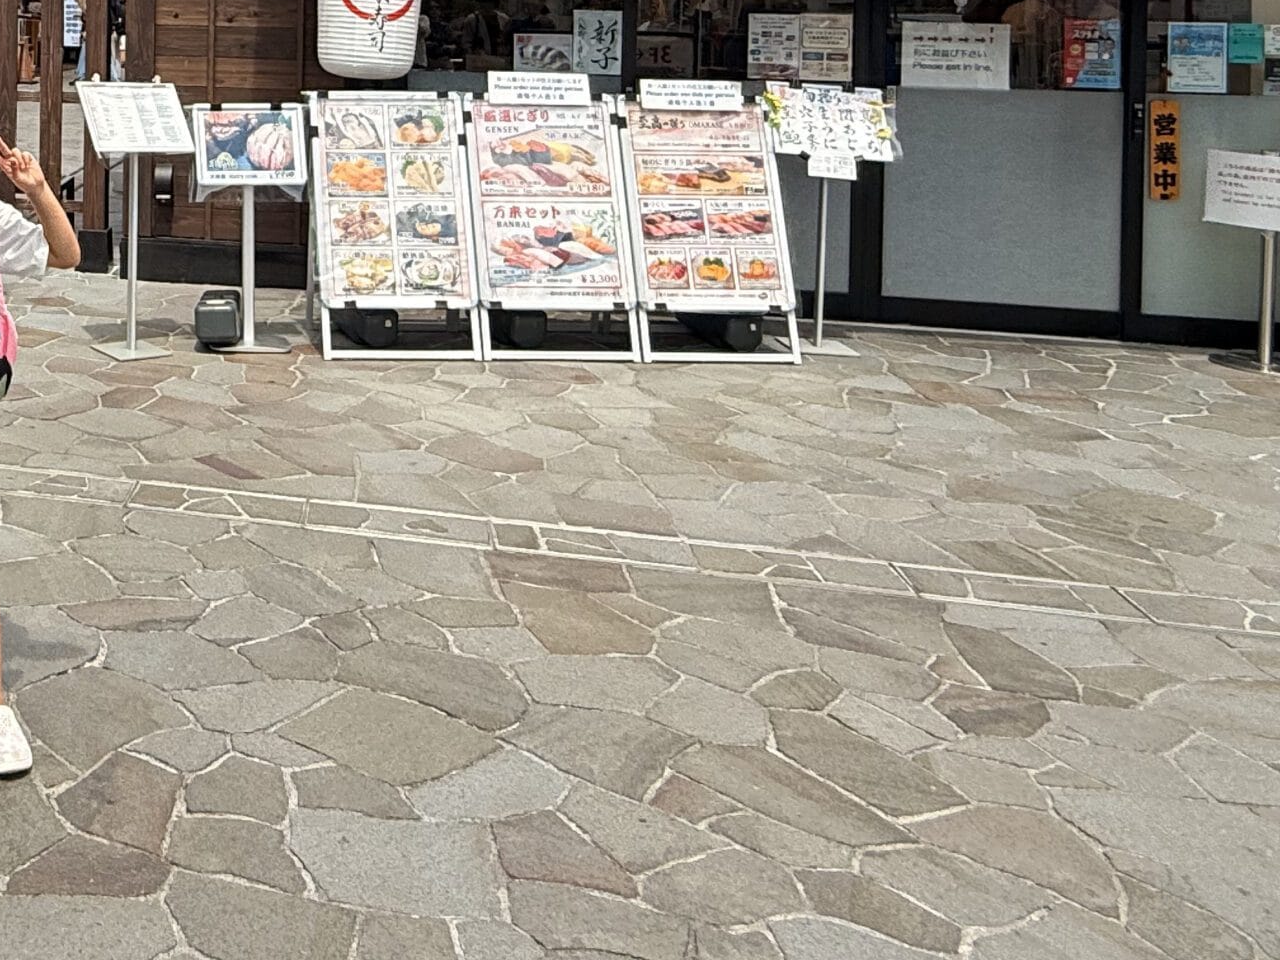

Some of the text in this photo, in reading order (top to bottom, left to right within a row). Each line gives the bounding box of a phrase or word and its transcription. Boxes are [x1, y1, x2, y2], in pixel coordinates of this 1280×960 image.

[590, 19, 619, 70] 新子
[912, 62, 943, 70] Please
[963, 63, 972, 71] in
[974, 63, 993, 72] line.
[484, 109, 550, 123] 厳選にぎり
[485, 126, 519, 134] GENSEN
[1153, 112, 1177, 191] 営業中
[493, 205, 561, 219] 万来セット
[581, 274, 618, 284] ¥3,300
